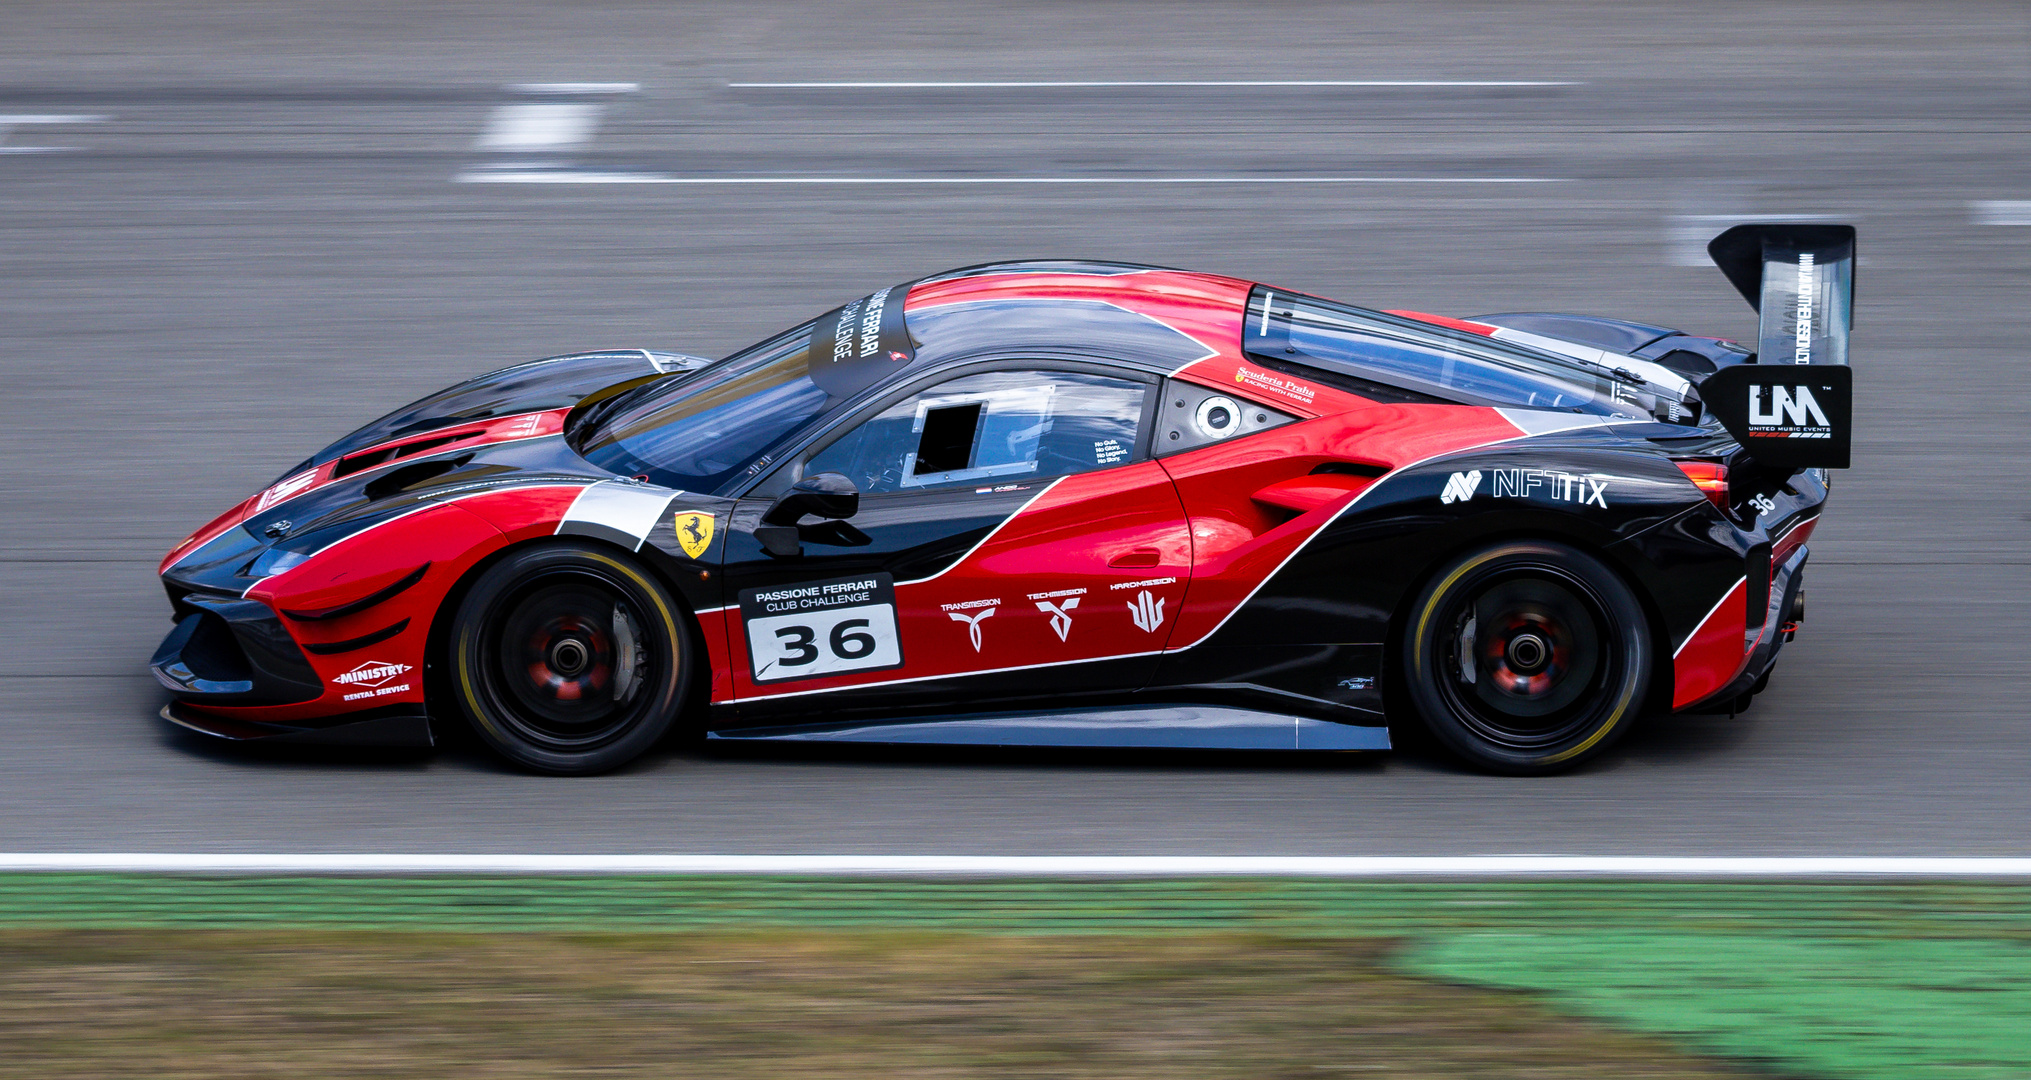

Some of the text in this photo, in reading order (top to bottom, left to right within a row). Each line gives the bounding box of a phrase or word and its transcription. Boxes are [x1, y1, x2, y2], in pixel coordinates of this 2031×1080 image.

[833, 304, 861, 362] CHALLENGE
[860, 308, 882, 358] FERRARI
[1237, 367, 1315, 397] Scuderia Praha
[1244, 378, 1313, 404] RACING WITH FERRARI
[1747, 493, 1776, 516] 36
[755, 579, 877, 603] PASSIONE FERRARI
[1026, 587, 1087, 600] TECHMISSION
[1110, 576, 1176, 591] HARDMISSION
[766, 591, 870, 612] CLUB CHALLENGE
[940, 597, 1001, 612] TRANSMISSION
[774, 618, 876, 667] 36
[340, 663, 404, 684] MINISTRY
[343, 684, 410, 701] RENTAL SERVICE
